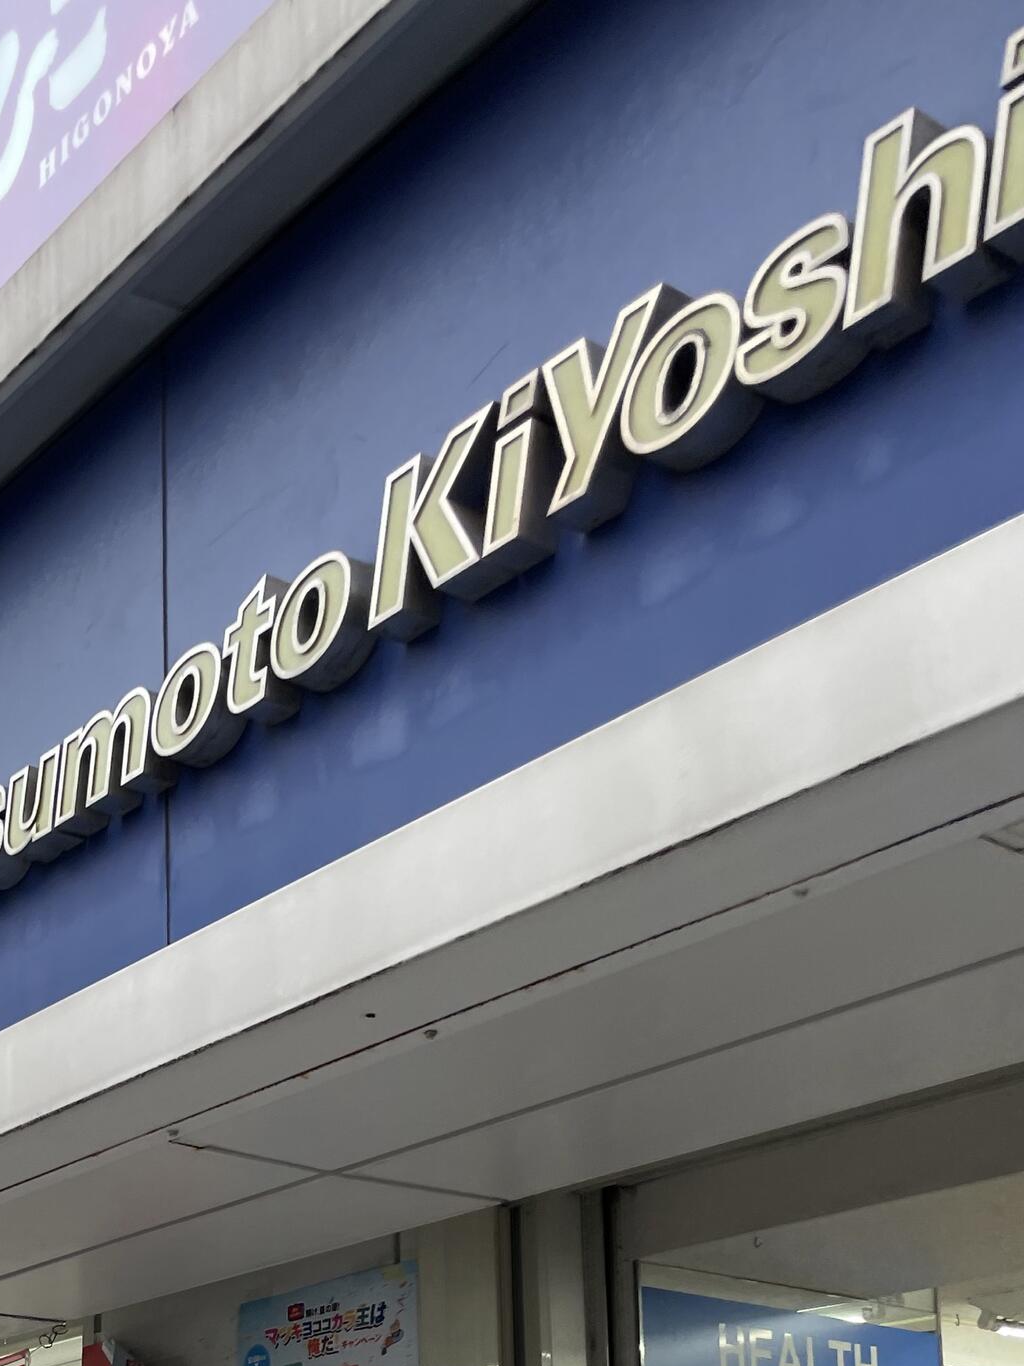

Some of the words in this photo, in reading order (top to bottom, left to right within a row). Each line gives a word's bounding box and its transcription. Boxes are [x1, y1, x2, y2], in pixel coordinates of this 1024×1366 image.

[38, 4, 200, 190] HIGONOYA
[264, 1300, 388, 1349] マツキヨココカラ王は
